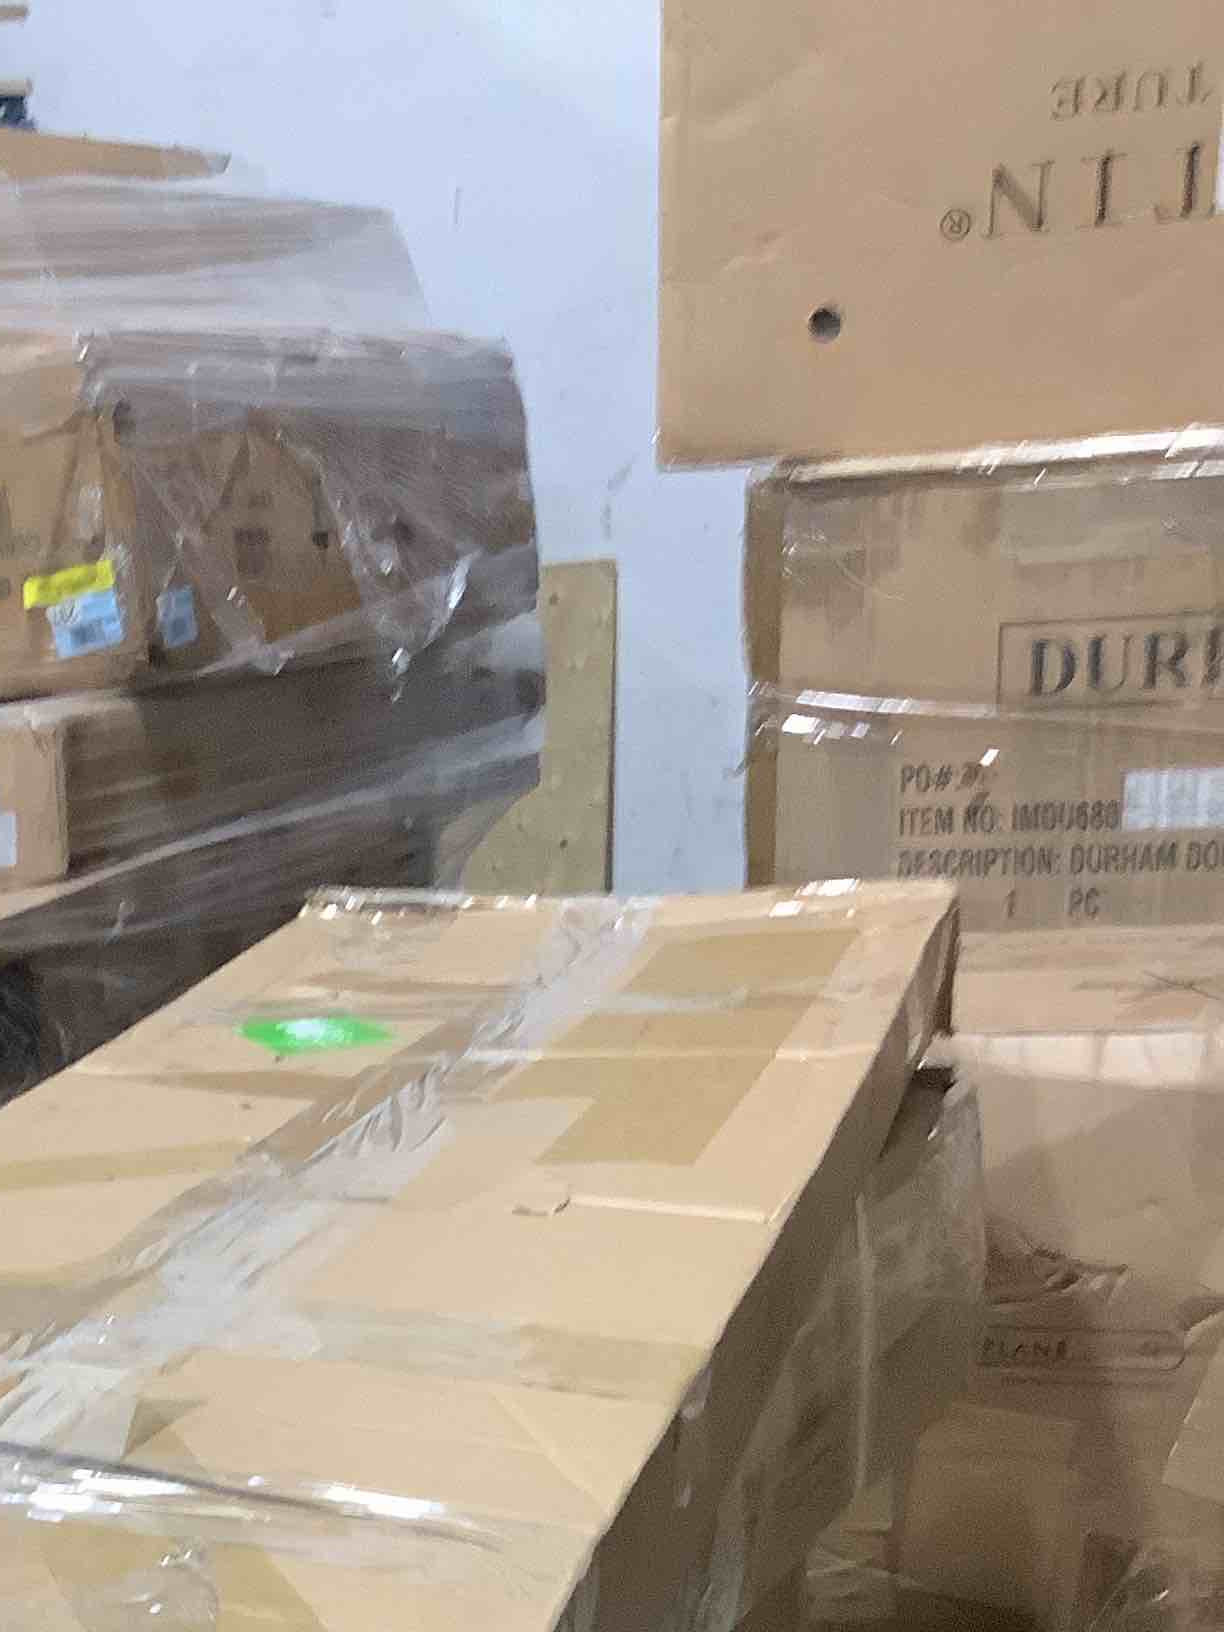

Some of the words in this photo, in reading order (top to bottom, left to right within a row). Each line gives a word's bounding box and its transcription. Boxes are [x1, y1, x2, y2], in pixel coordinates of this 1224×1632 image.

[899, 805, 955, 836] ITEM
[1069, 841, 1180, 875] DURHAM
[1067, 886, 1101, 919] PC
